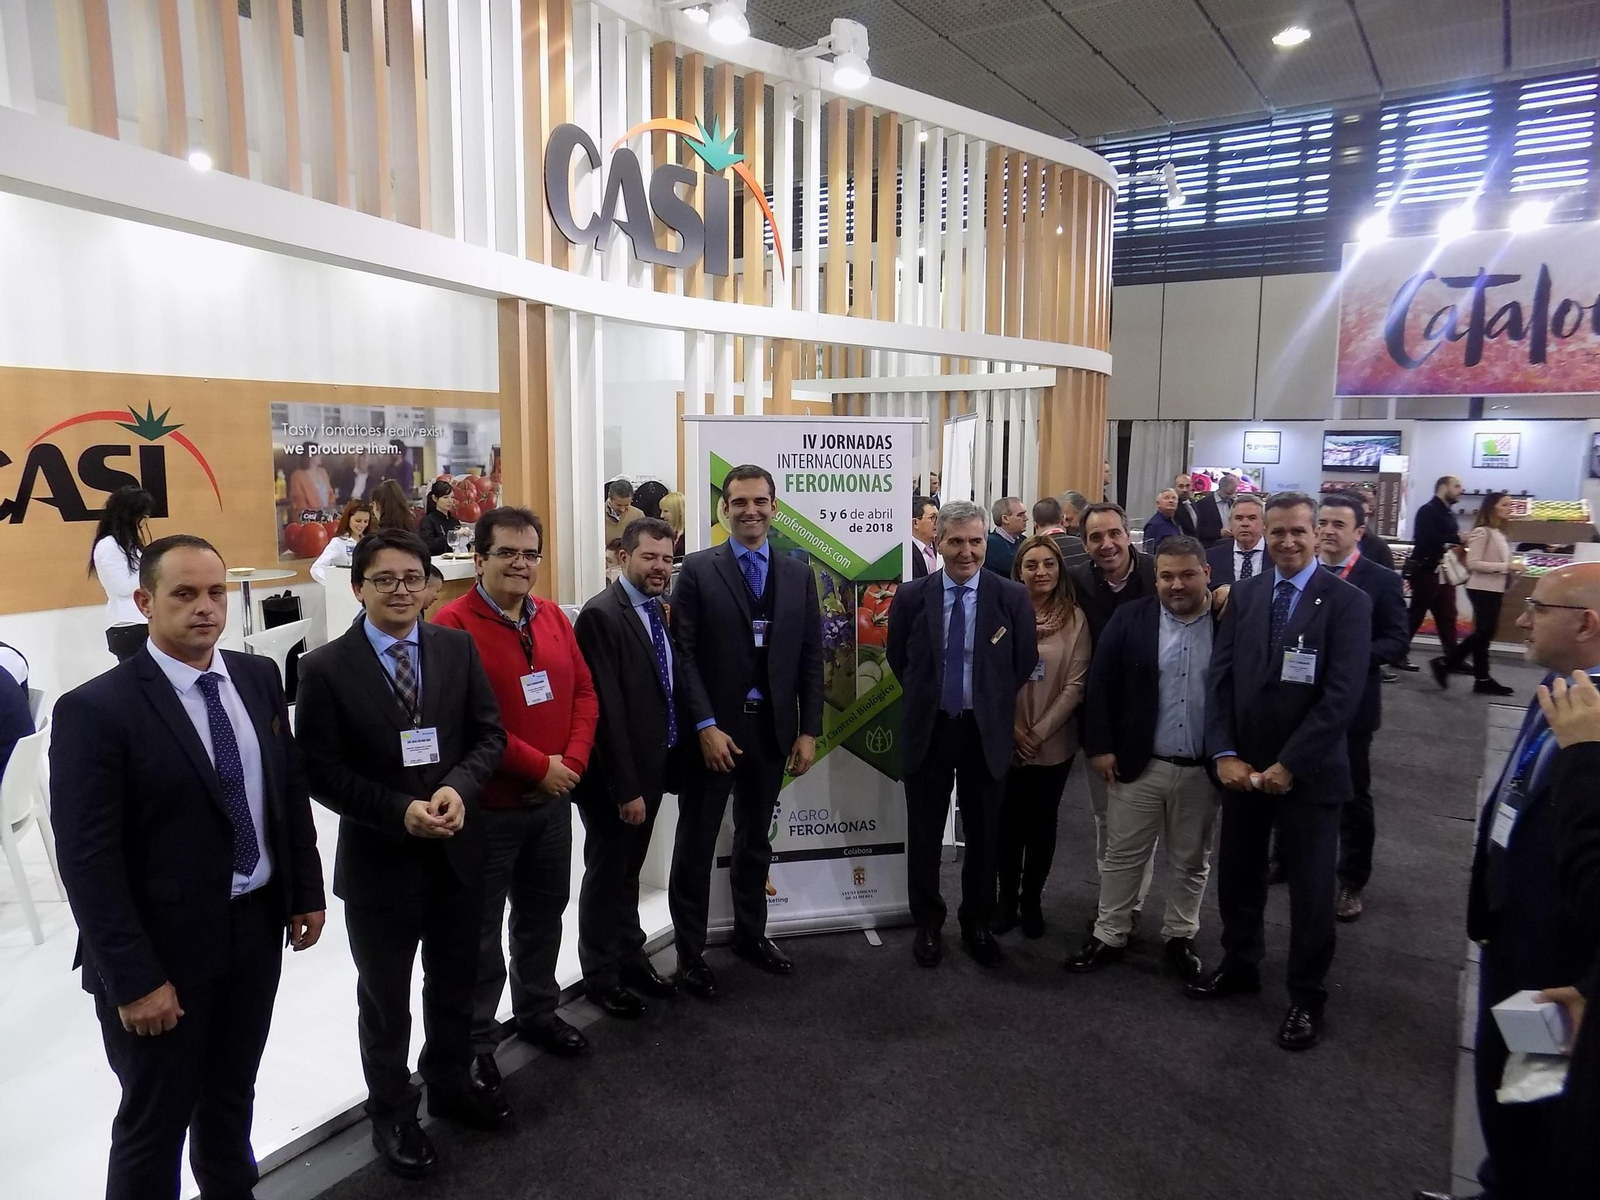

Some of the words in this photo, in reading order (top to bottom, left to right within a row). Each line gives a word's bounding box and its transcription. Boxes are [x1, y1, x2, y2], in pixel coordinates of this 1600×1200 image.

[544, 122, 729, 277] CASI
[1384, 263, 1600, 369] Catalo
[281, 423, 316, 438] Tasty
[321, 423, 381, 437] tomatoes
[384, 425, 416, 438] really
[283, 444, 304, 455] we
[308, 443, 364, 457] produce
[367, 443, 402, 455] them.
[803, 434, 817, 449] IV
[820, 434, 893, 450] JORNADAS
[777, 453, 893, 469] INTERNACIONALES
[785, 473, 893, 493] FEROMONAS
[819, 509, 827, 520] 5
[830, 511, 837, 522] y
[840, 509, 847, 520] 6
[850, 508, 865, 520] de
[867, 508, 893, 520] abril
[849, 523, 863, 533] de
[866, 523, 893, 533] 2018
[773, 510, 852, 569] groferomonas.com
[820, 738, 827, 748] y
[826, 712, 858, 740] Control
[856, 684, 895, 716] Biológico
[788, 808, 829, 822] AGRO
[789, 820, 876, 837] FEROMONAS
[843, 848, 873, 856] Colabora
